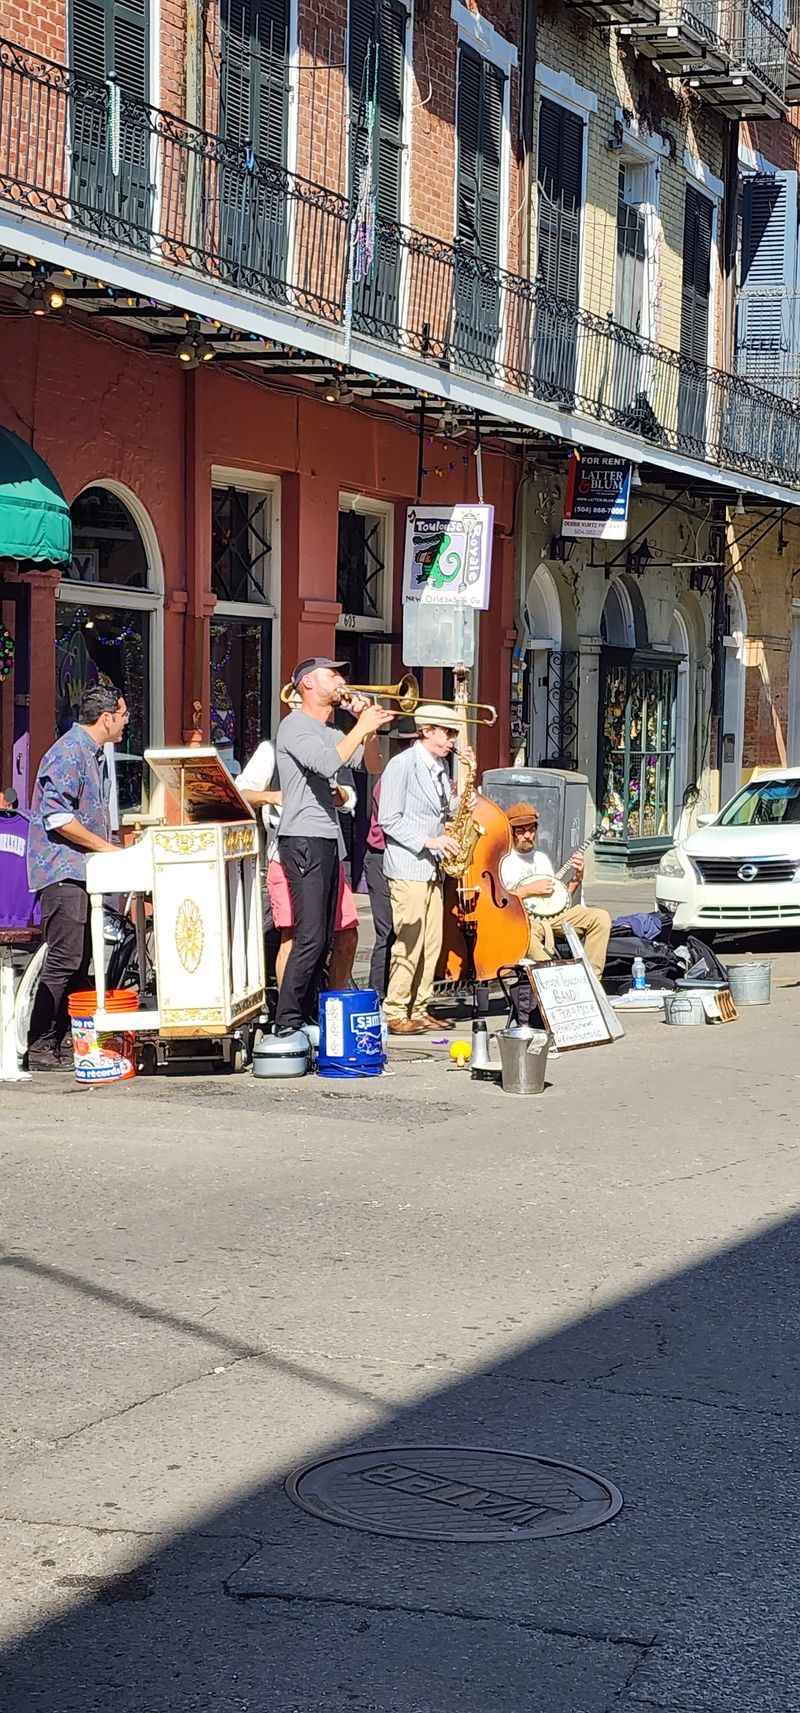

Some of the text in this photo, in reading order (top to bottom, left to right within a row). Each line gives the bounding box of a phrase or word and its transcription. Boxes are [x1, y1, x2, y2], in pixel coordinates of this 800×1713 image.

[581, 457, 626, 466] FOR RENT
[581, 470, 623, 480] LATTER
[591, 479, 624, 490] BLUM
[574, 506, 591, 514] (504)
[416, 520, 462, 533] Toulouse
